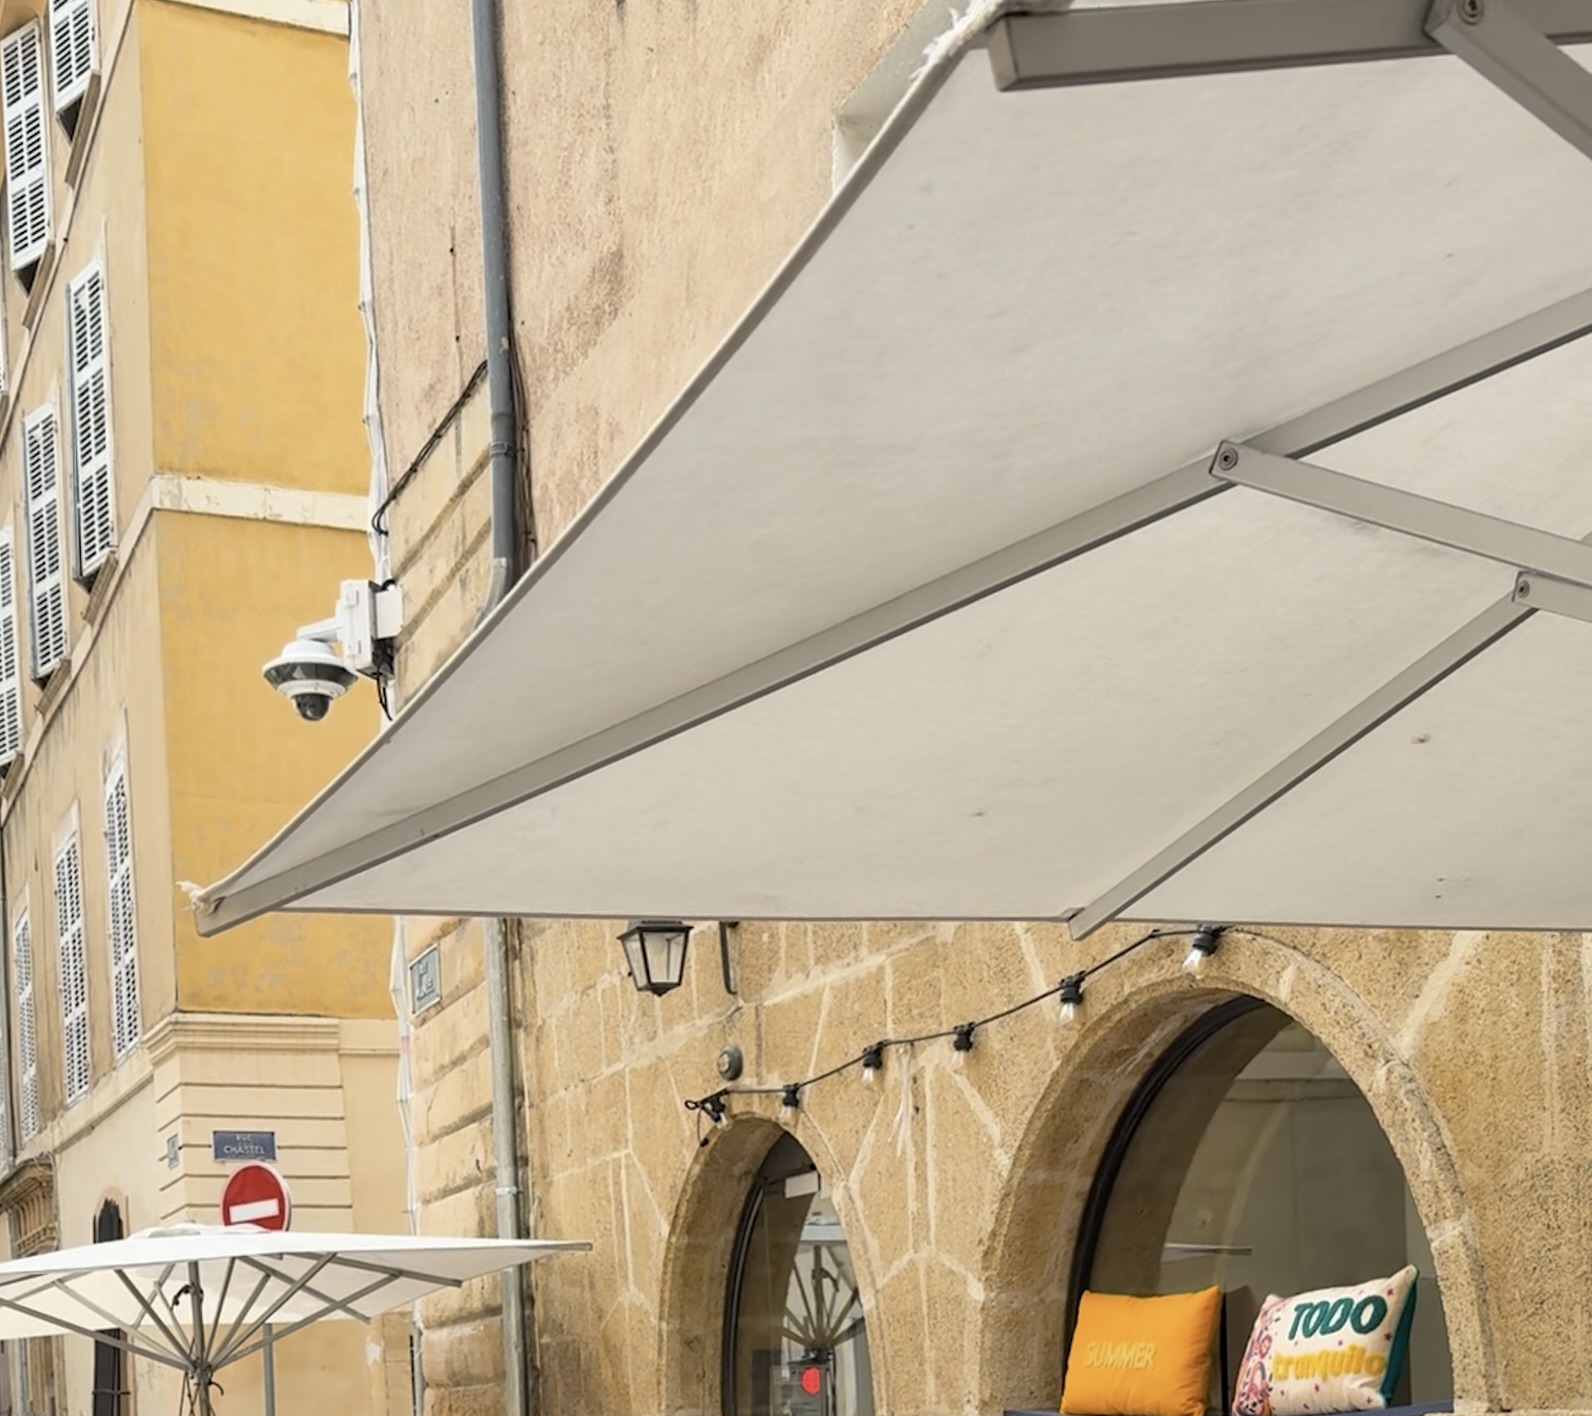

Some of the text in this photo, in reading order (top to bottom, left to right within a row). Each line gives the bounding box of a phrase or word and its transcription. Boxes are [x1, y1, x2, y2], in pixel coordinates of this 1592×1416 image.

[1288, 1295, 1388, 1340] TODO
[1085, 1341, 1155, 1369] SUMMER
[1273, 1344, 1386, 1381] tranquilo
